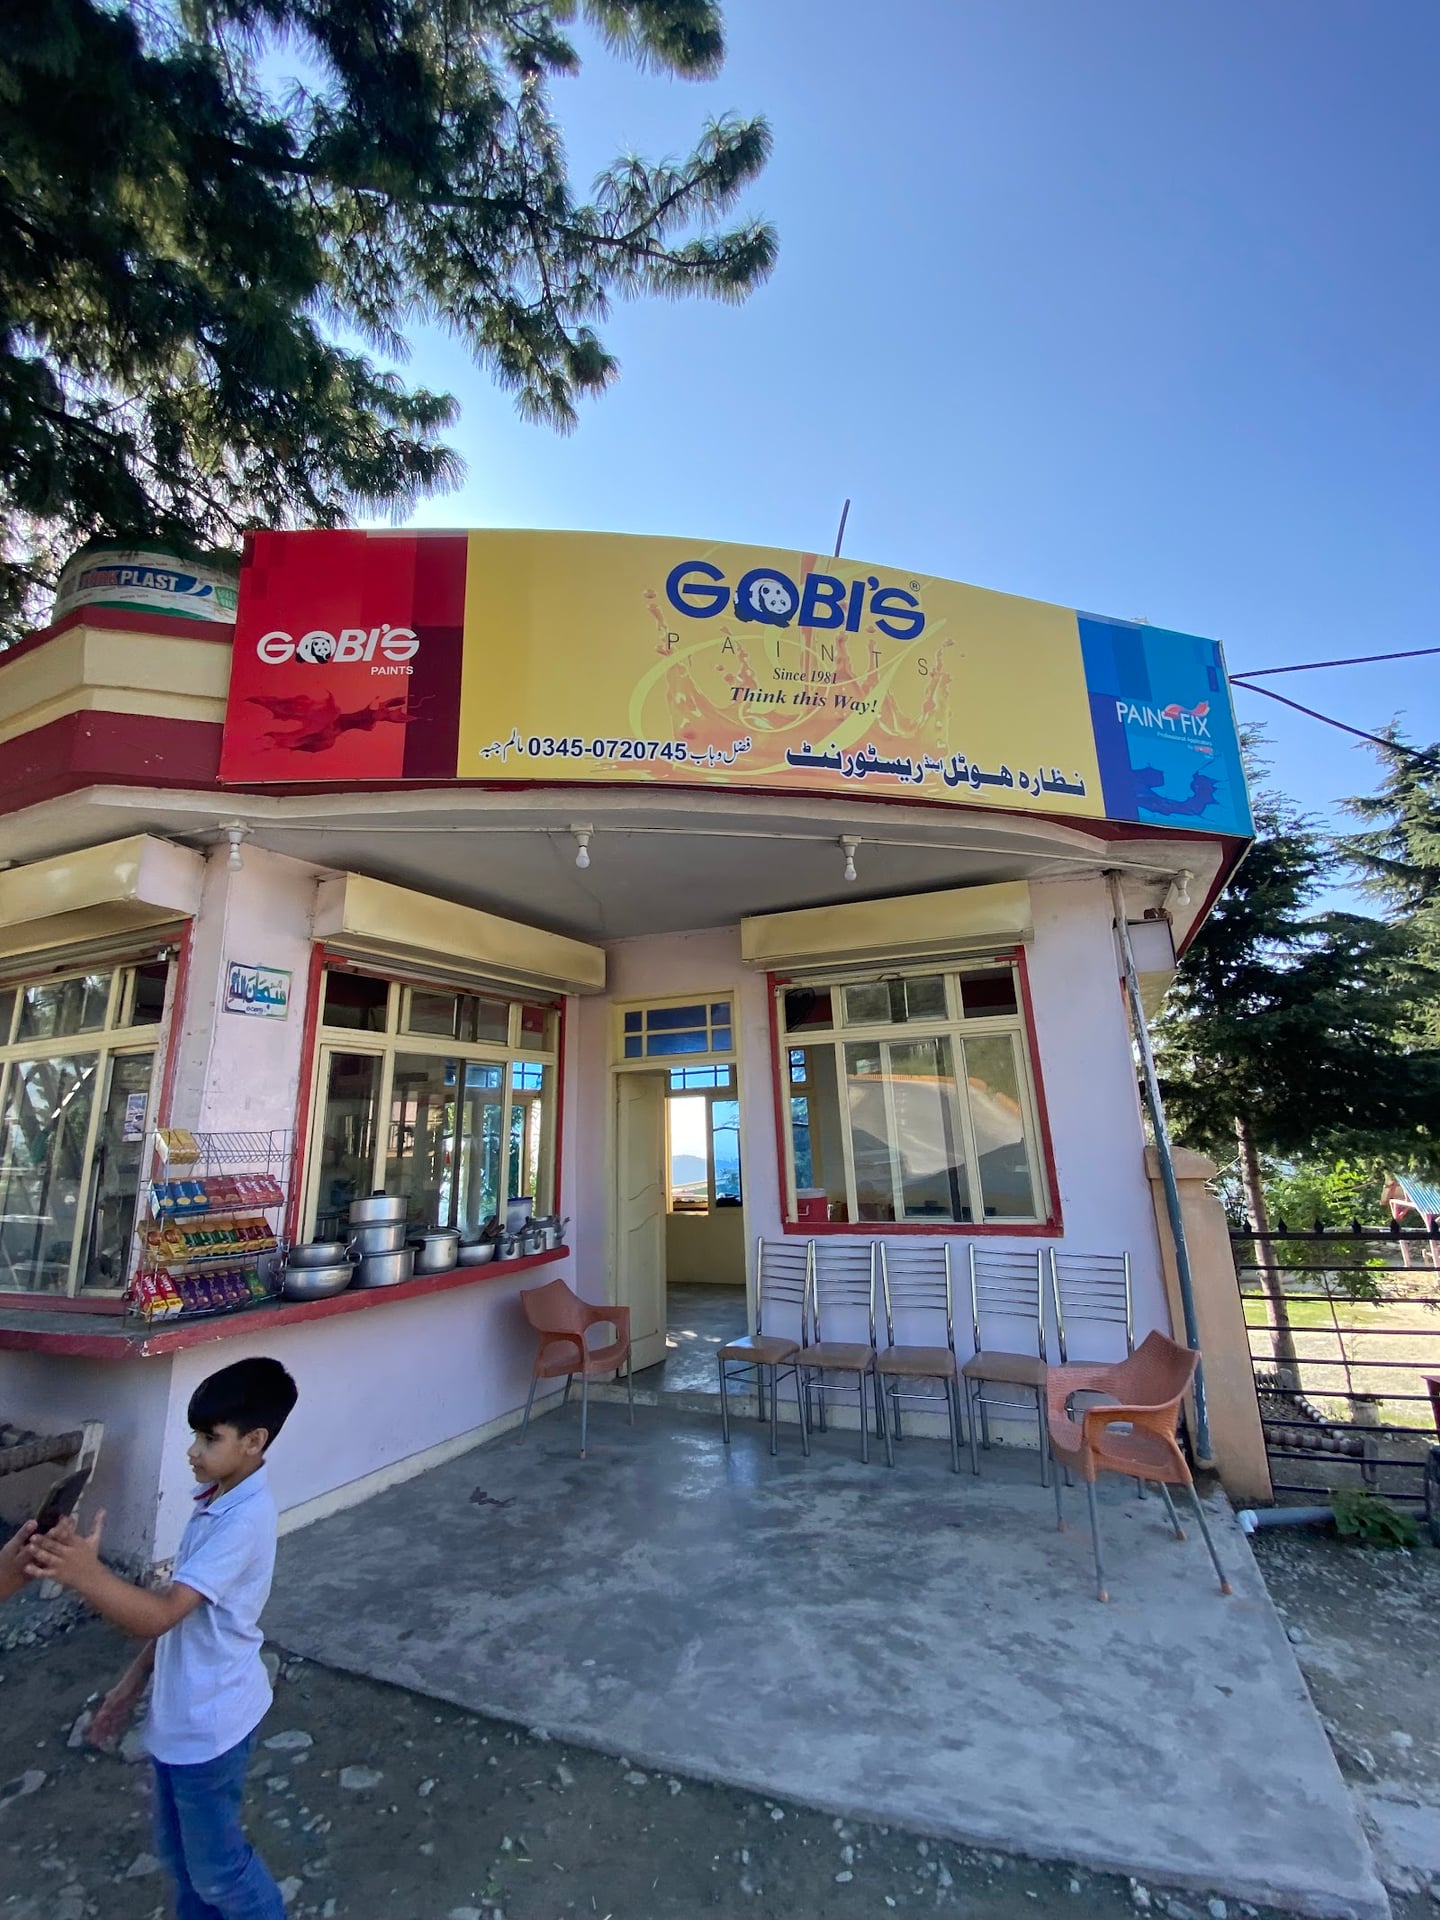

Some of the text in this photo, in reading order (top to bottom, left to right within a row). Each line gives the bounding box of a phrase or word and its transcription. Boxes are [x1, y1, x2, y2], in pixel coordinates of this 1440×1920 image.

[119, 570, 179, 591] PLAST
[666, 560, 926, 640] GOBI'S
[256, 623, 420, 665] GOBI'S
[370, 665, 414, 676] PAINTS
[773, 667, 837, 685] Since 1981
[730, 686, 878, 715] Think this Way!
[528, 737, 687, 761] 0345-0720745
[723, 737, 751, 764] فضل
